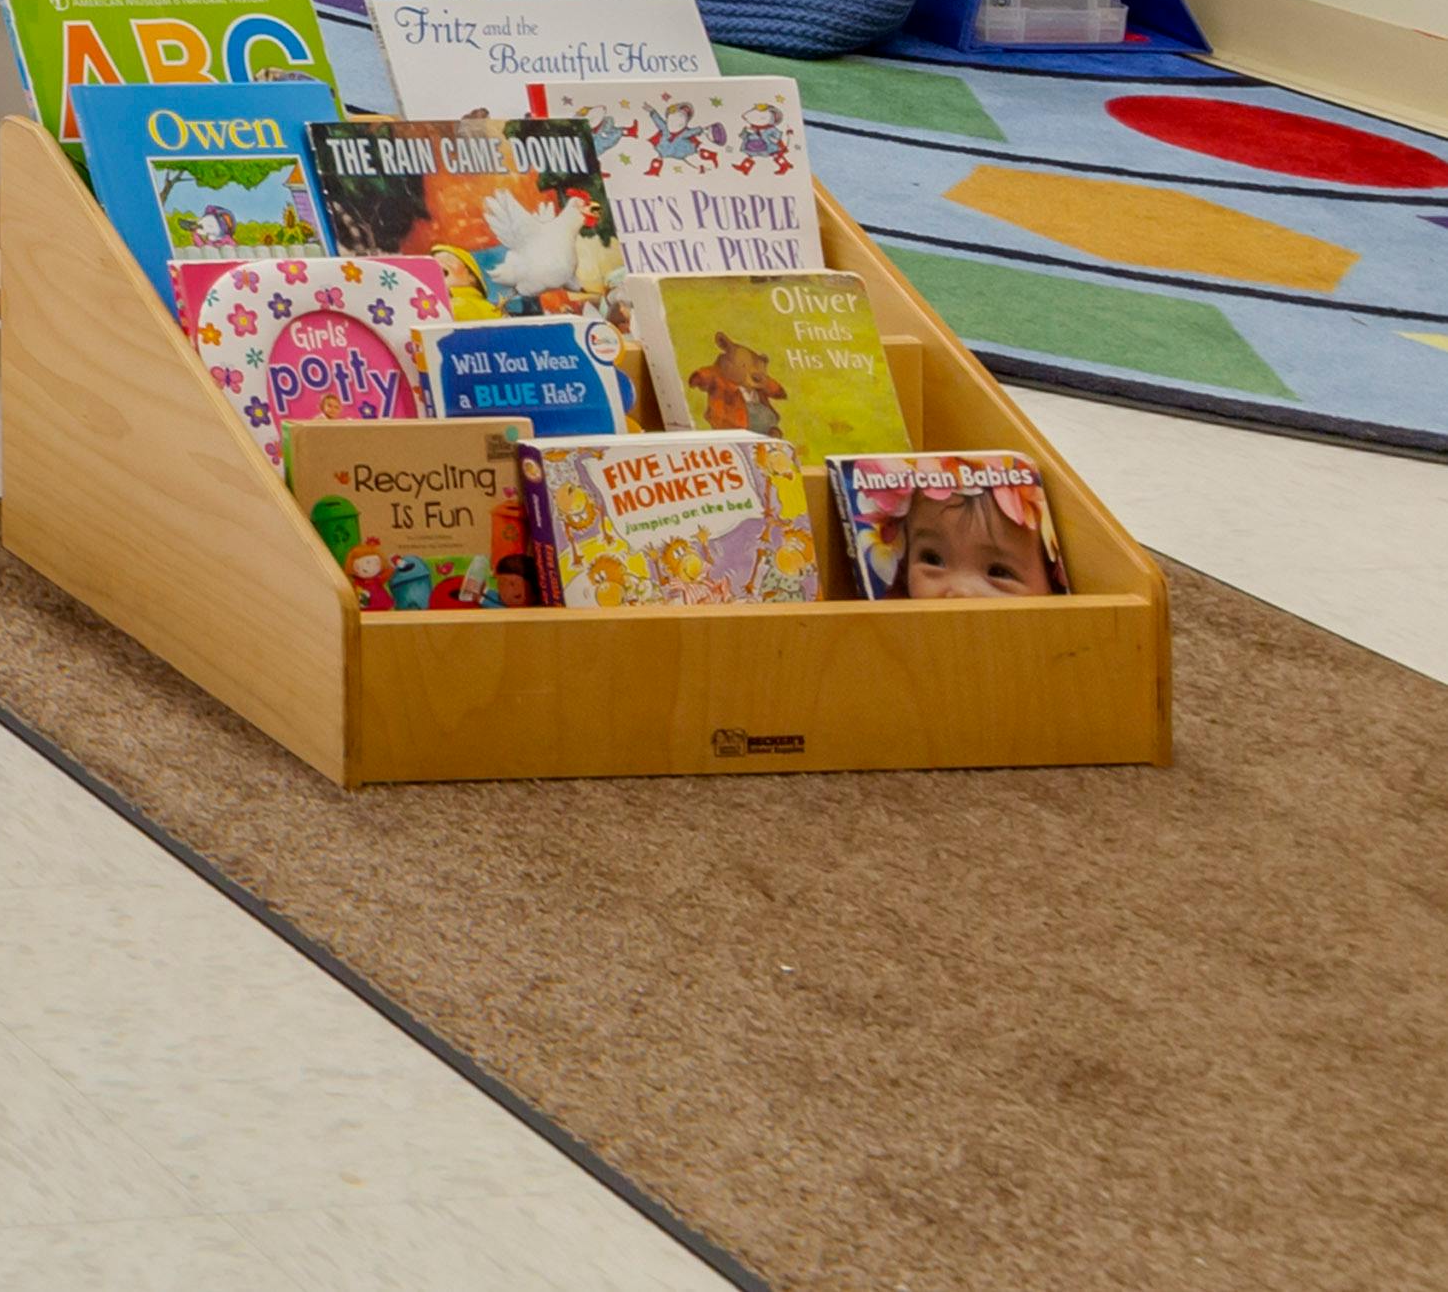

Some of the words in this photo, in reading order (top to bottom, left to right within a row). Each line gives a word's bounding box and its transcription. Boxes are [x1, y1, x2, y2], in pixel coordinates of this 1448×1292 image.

[394, 5, 481, 49] Fritz
[482, 15, 512, 36] and
[516, 15, 539, 36] the
[59, 13, 315, 143] ABC
[489, 42, 609, 80] Beautiful
[613, 42, 700, 73] Horses
[147, 109, 288, 150] Owen
[327, 137, 375, 175] THE
[378, 137, 436, 175] RAIN
[446, 136, 504, 175] CAME
[510, 135, 589, 174] DOWN
[615, 195, 684, 235] LLY'S
[692, 190, 801, 232] PURPLE
[621, 239, 706, 274] LASTIC
[718, 236, 805, 273] PURSE
[771, 286, 857, 315] Oliver
[793, 320, 853, 342] Finds
[451, 353, 491, 376] Will
[493, 353, 528, 374] You
[533, 351, 580, 372] Wear
[786, 348, 824, 369] His
[827, 348, 876, 375] Way
[269, 347, 402, 417] potty
[459, 392, 472, 410] a
[475, 383, 538, 409] BLUE
[542, 384, 588, 406] Hat?
[354, 463, 497, 499] Recycling
[603, 453, 664, 490] FIVE
[668, 446, 734, 474] Little
[852, 467, 956, 490] American
[958, 465, 1034, 487] Babies
[611, 466, 745, 517] MONKEYS
[425, 501, 475, 528] Fun
[625, 513, 681, 535] jumping
[683, 506, 700, 520] on
[701, 501, 724, 516] the
[726, 497, 754, 512] bed
